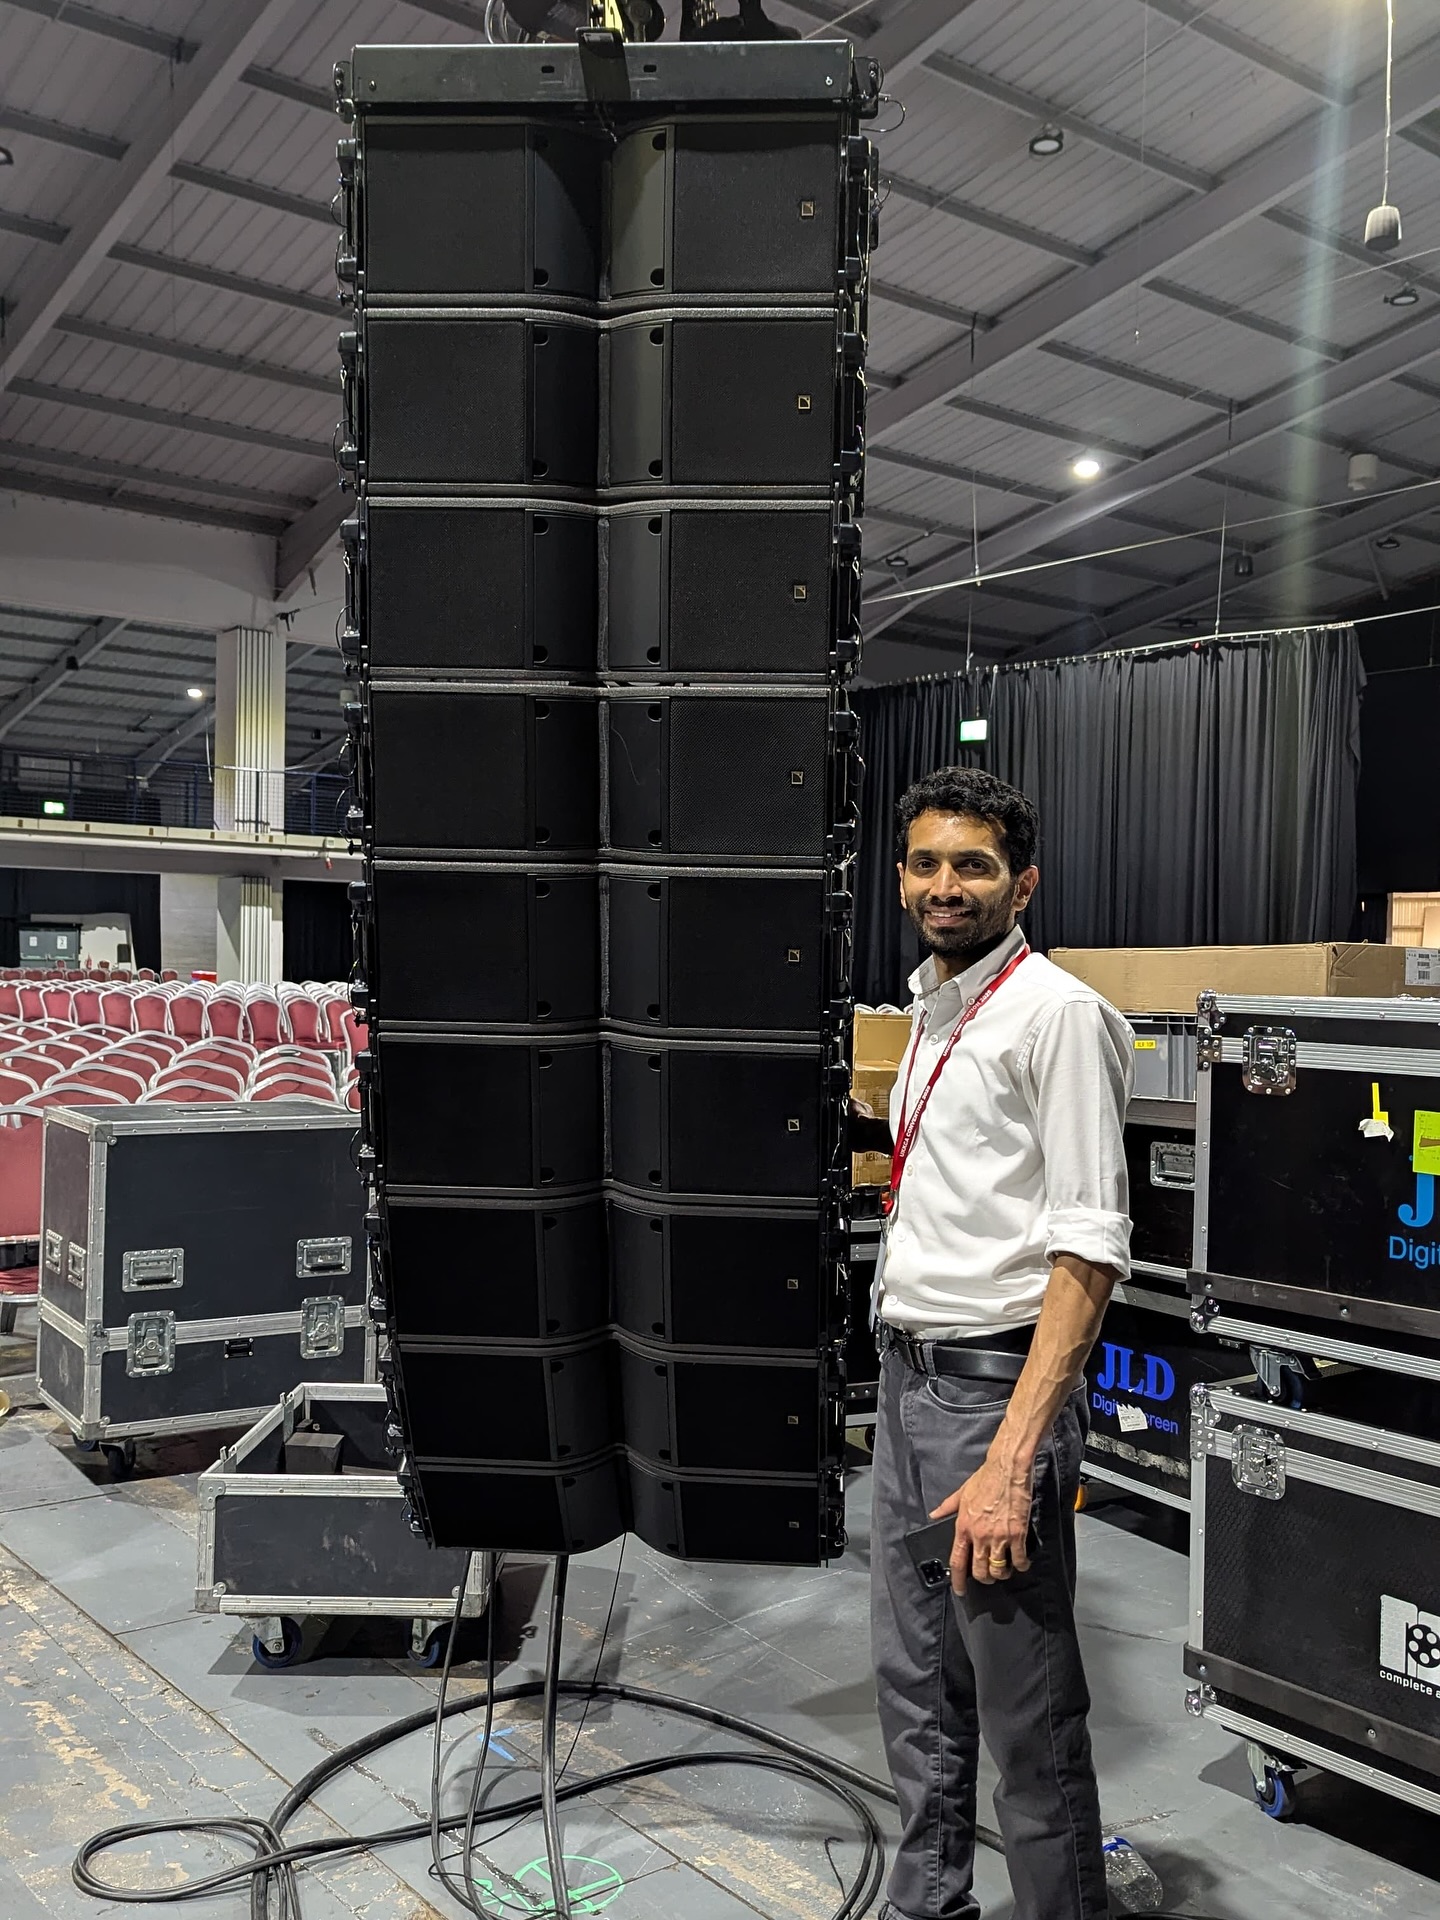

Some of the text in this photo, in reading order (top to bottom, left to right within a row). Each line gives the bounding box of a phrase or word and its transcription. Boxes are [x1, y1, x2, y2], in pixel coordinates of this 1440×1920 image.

[953, 1002, 981, 1036] CONVENTION
[905, 1099, 925, 1137] CONVENTION
[1389, 1235, 1440, 1270] Digi
[1097, 1341, 1175, 1402] JLD
[1093, 1392, 1119, 1416] Digi
[1379, 1670, 1434, 1696] complete
